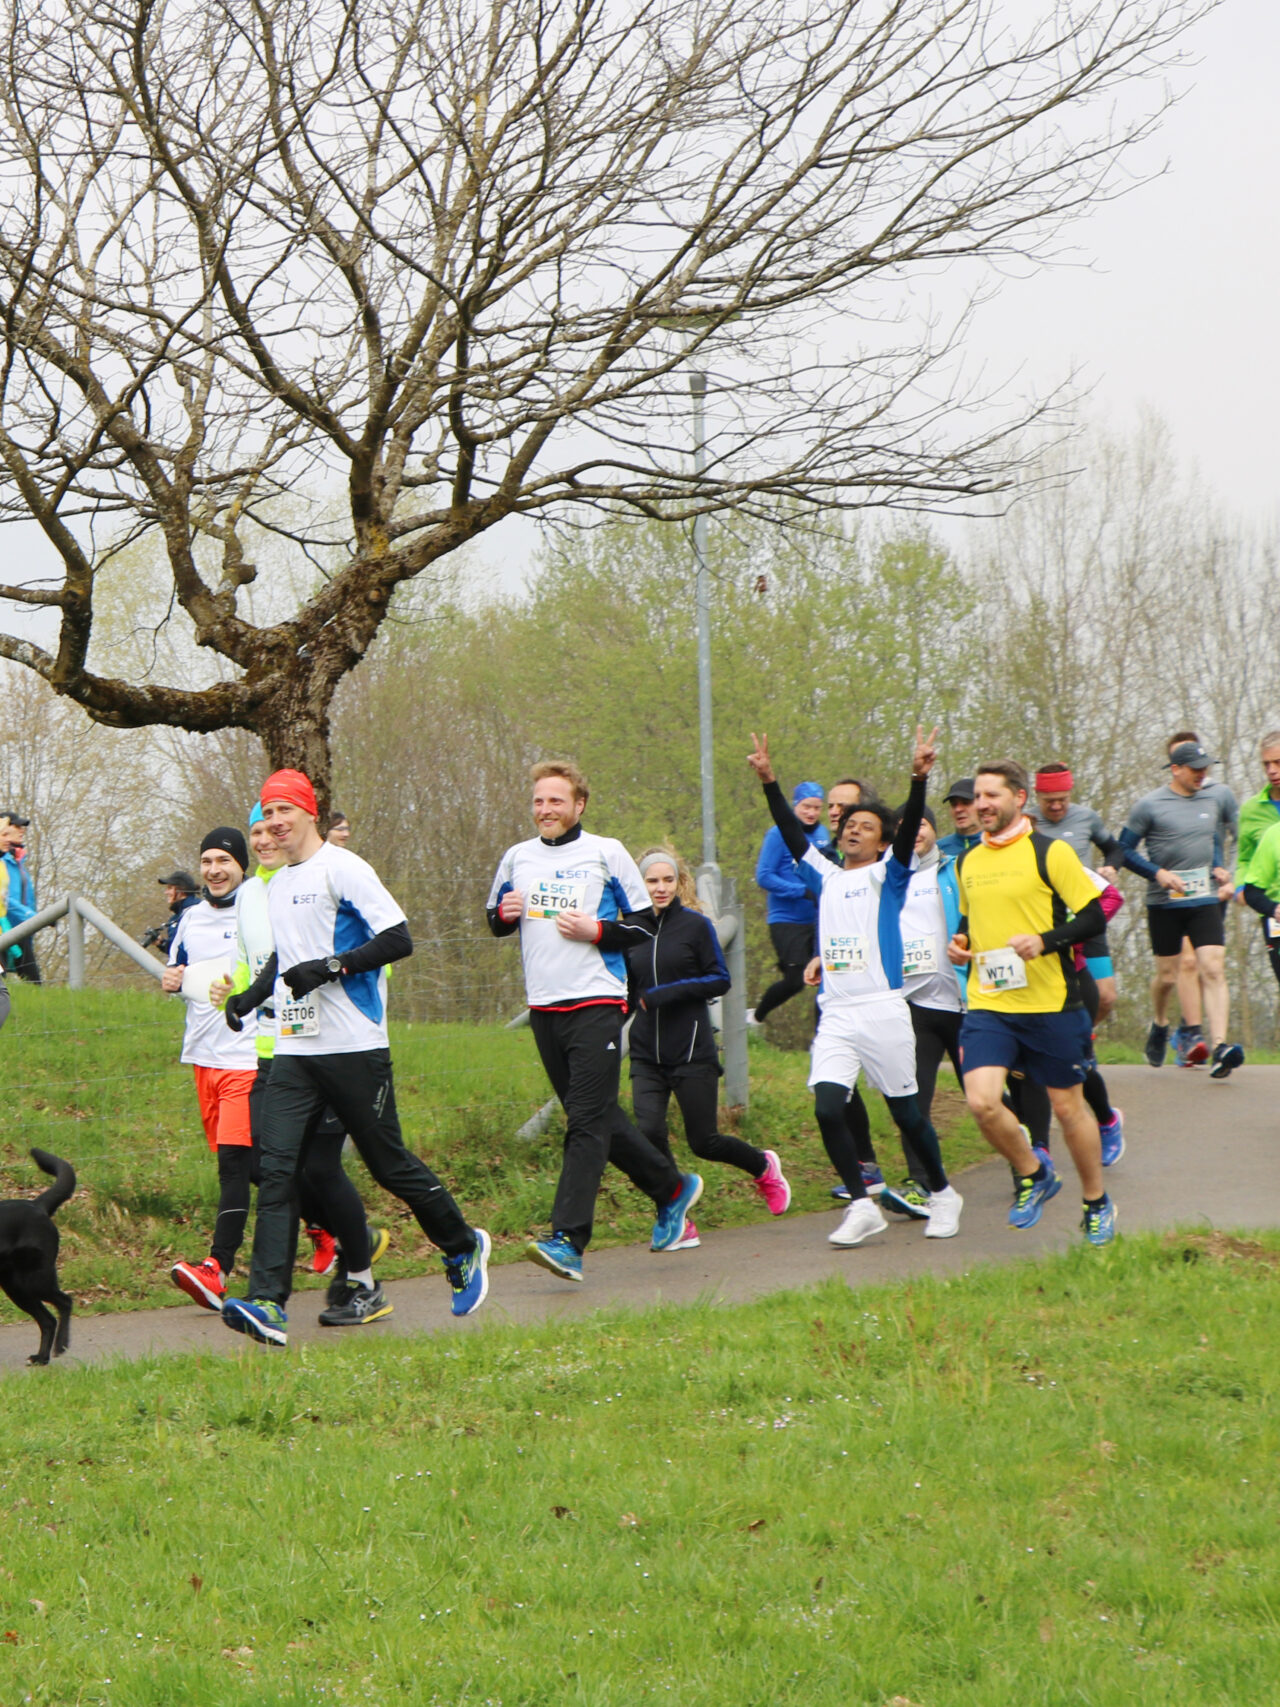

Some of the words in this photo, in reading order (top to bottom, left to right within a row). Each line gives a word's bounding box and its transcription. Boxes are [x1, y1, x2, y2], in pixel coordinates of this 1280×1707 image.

[565, 870, 590, 879] SET
[550, 885, 575, 895] SET
[851, 887, 869, 897] SET
[299, 894, 318, 905] SET
[531, 894, 578, 910] SET04
[838, 937, 859, 947] SET
[904, 939, 925, 951] SET
[824, 948, 863, 960] SET11
[985, 964, 1014, 980] W71
[281, 1006, 315, 1022] SET06
